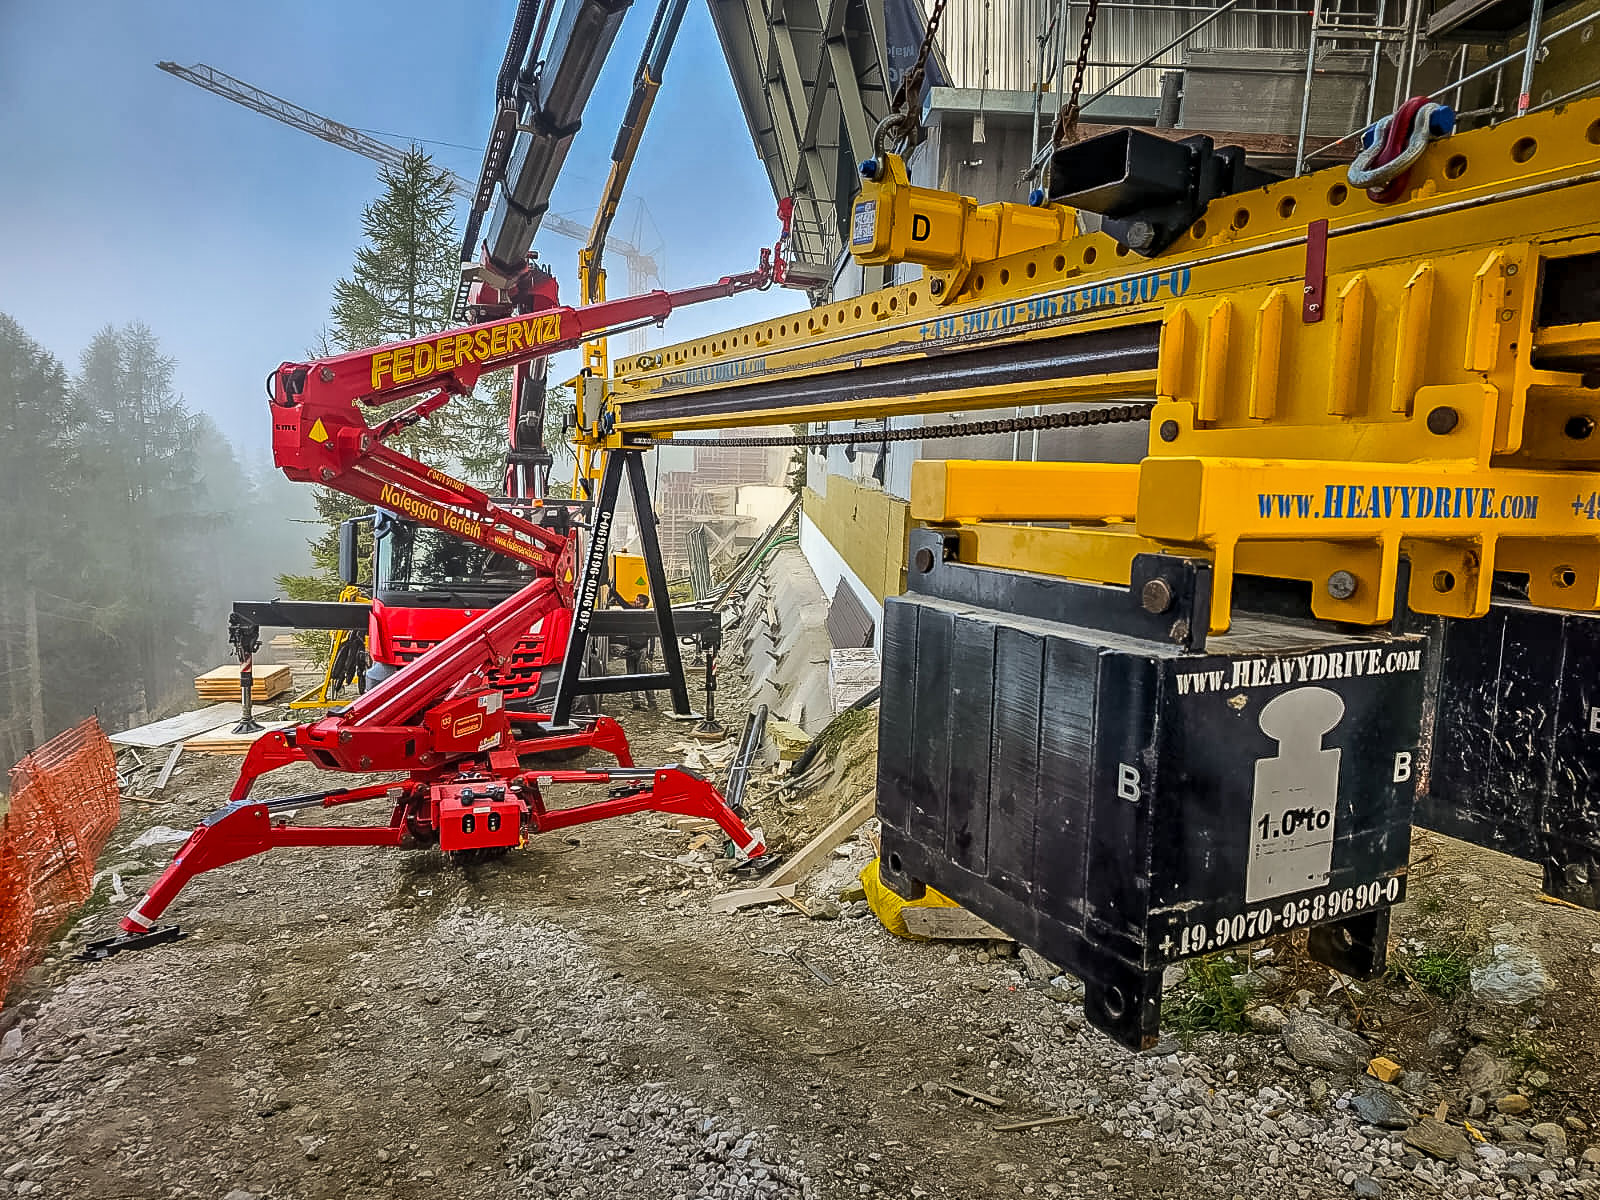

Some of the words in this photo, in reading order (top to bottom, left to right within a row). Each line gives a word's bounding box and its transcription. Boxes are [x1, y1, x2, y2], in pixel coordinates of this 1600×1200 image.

[912, 213, 931, 241] D
[370, 314, 562, 390] FEDERSERVIZI
[380, 484, 440, 522] Noleggio
[443, 508, 481, 539] Verleih
[1117, 763, 1141, 802] B
[1393, 751, 1412, 783] B
